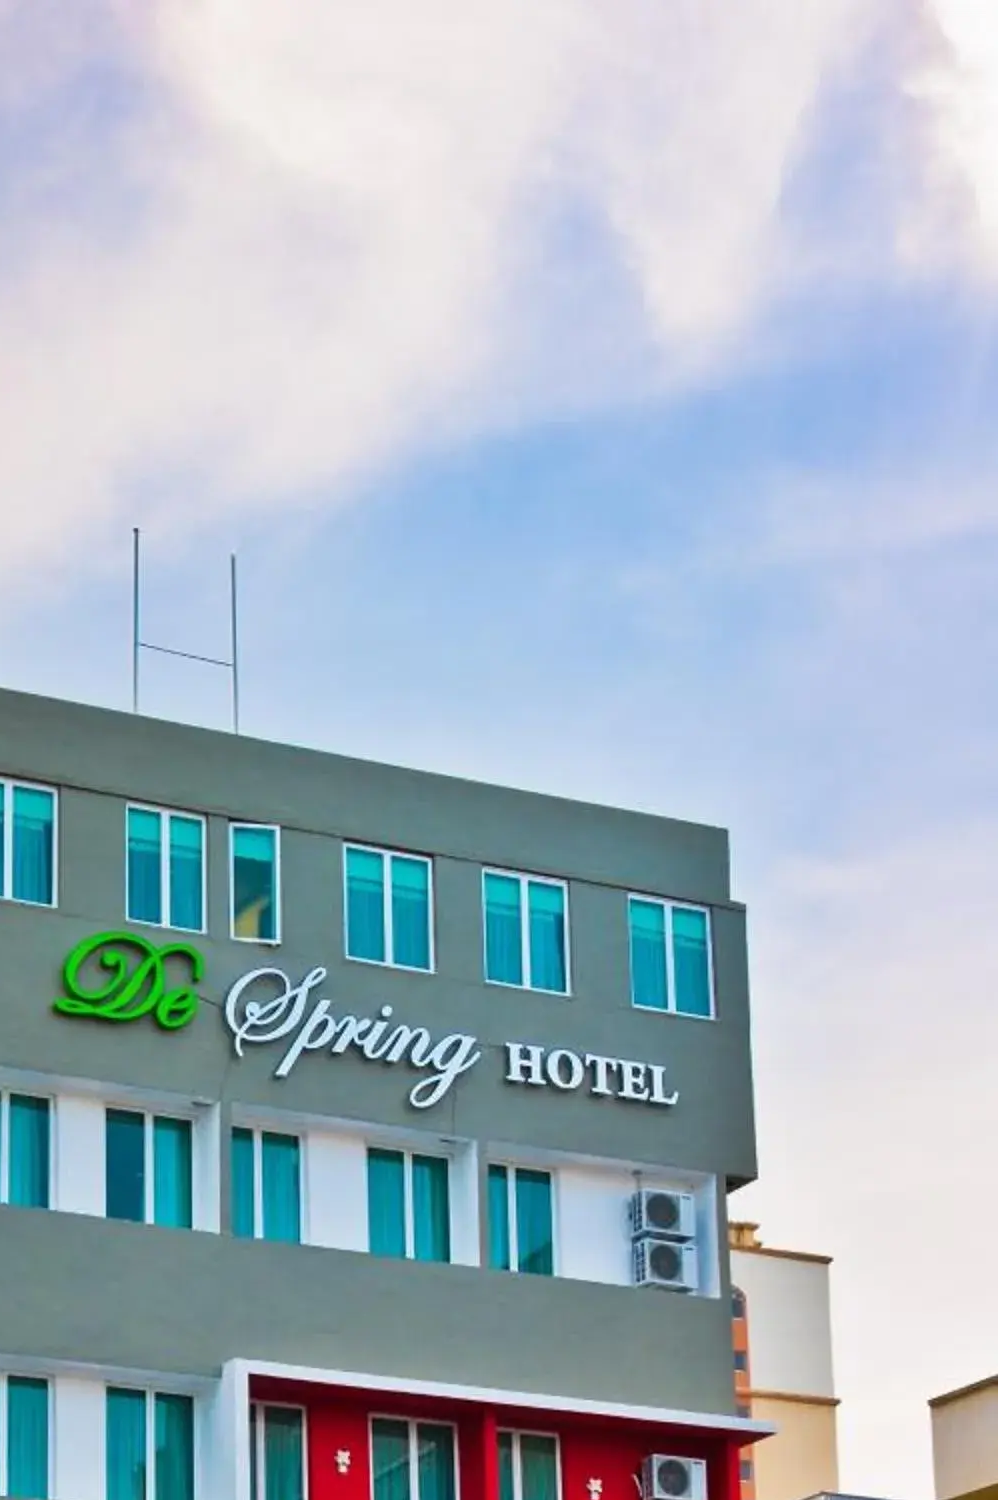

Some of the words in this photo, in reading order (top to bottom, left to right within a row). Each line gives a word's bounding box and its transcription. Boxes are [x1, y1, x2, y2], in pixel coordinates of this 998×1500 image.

[53, 930, 204, 1029] De
[225, 967, 481, 1108] Spring
[505, 1042, 679, 1106] HOTEL
